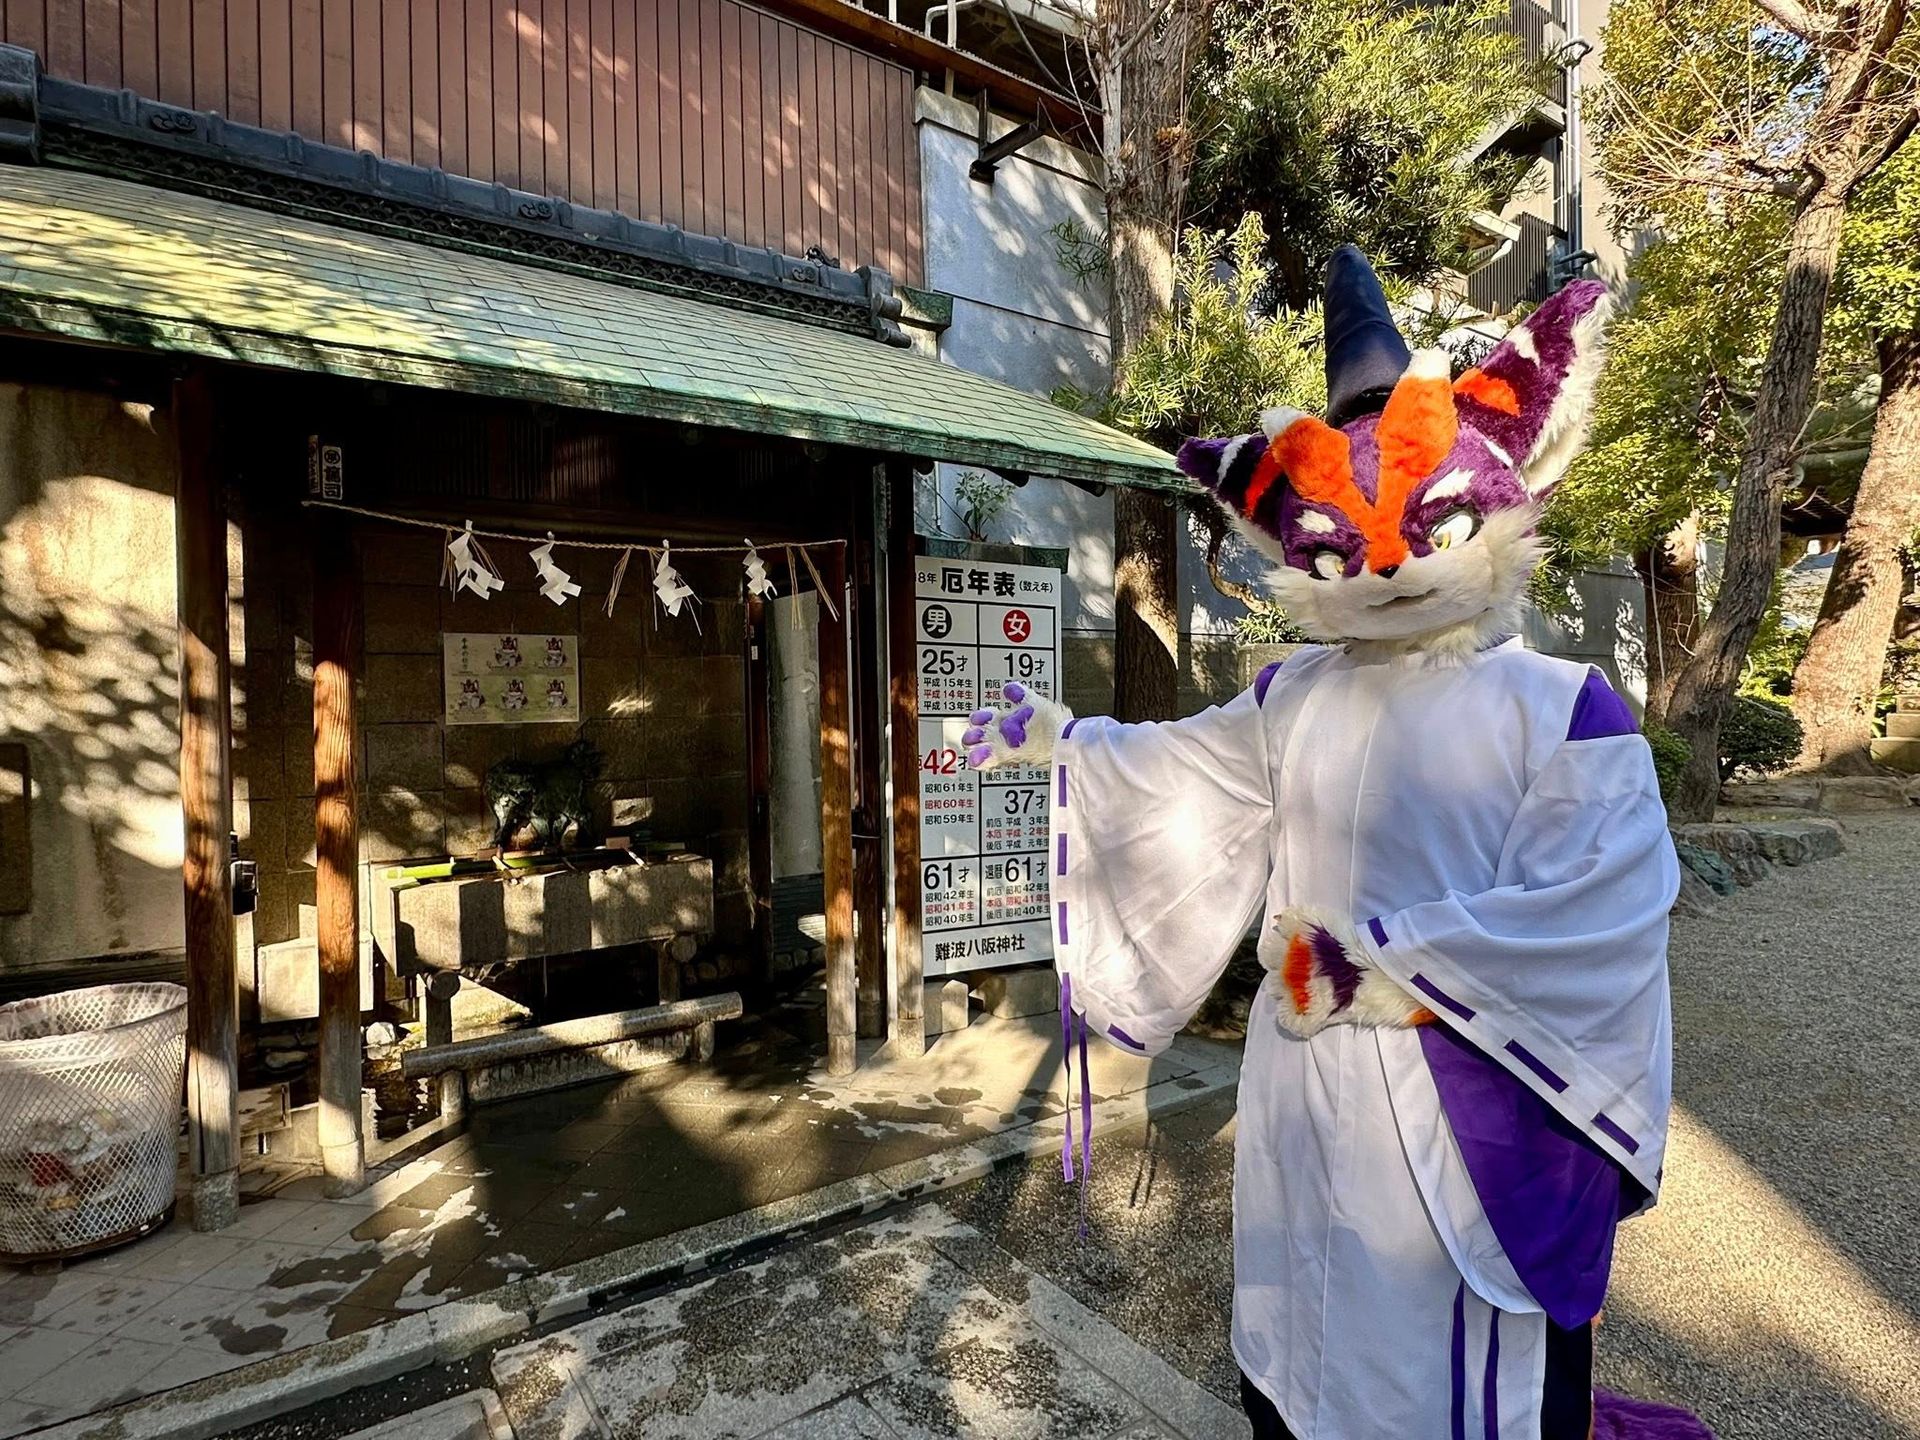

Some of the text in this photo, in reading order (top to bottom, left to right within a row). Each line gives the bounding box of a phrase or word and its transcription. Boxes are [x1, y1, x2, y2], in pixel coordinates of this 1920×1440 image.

[915, 567, 1054, 597] 8年 厄年表 (数え年)
[926, 608, 947, 634] 男
[1006, 613, 1027, 637] 女
[922, 649, 968, 675] 25才
[1004, 652, 1045, 677] 19才
[985, 679, 1001, 689] 前厄
[985, 691, 1001, 700] 本厄
[925, 783, 974, 793] 昭和61年生
[925, 799, 974, 810] 昭和60年生
[1004, 790, 1047, 814] 37才
[925, 814, 974, 825] 昭和59年生
[924, 862, 970, 890] 61才
[925, 890, 974, 903] 昭和42年生
[925, 901, 974, 914] 昭和41年生
[925, 913, 974, 926] 昭和40年生
[935, 933, 1025, 962] 難波八阪神社
